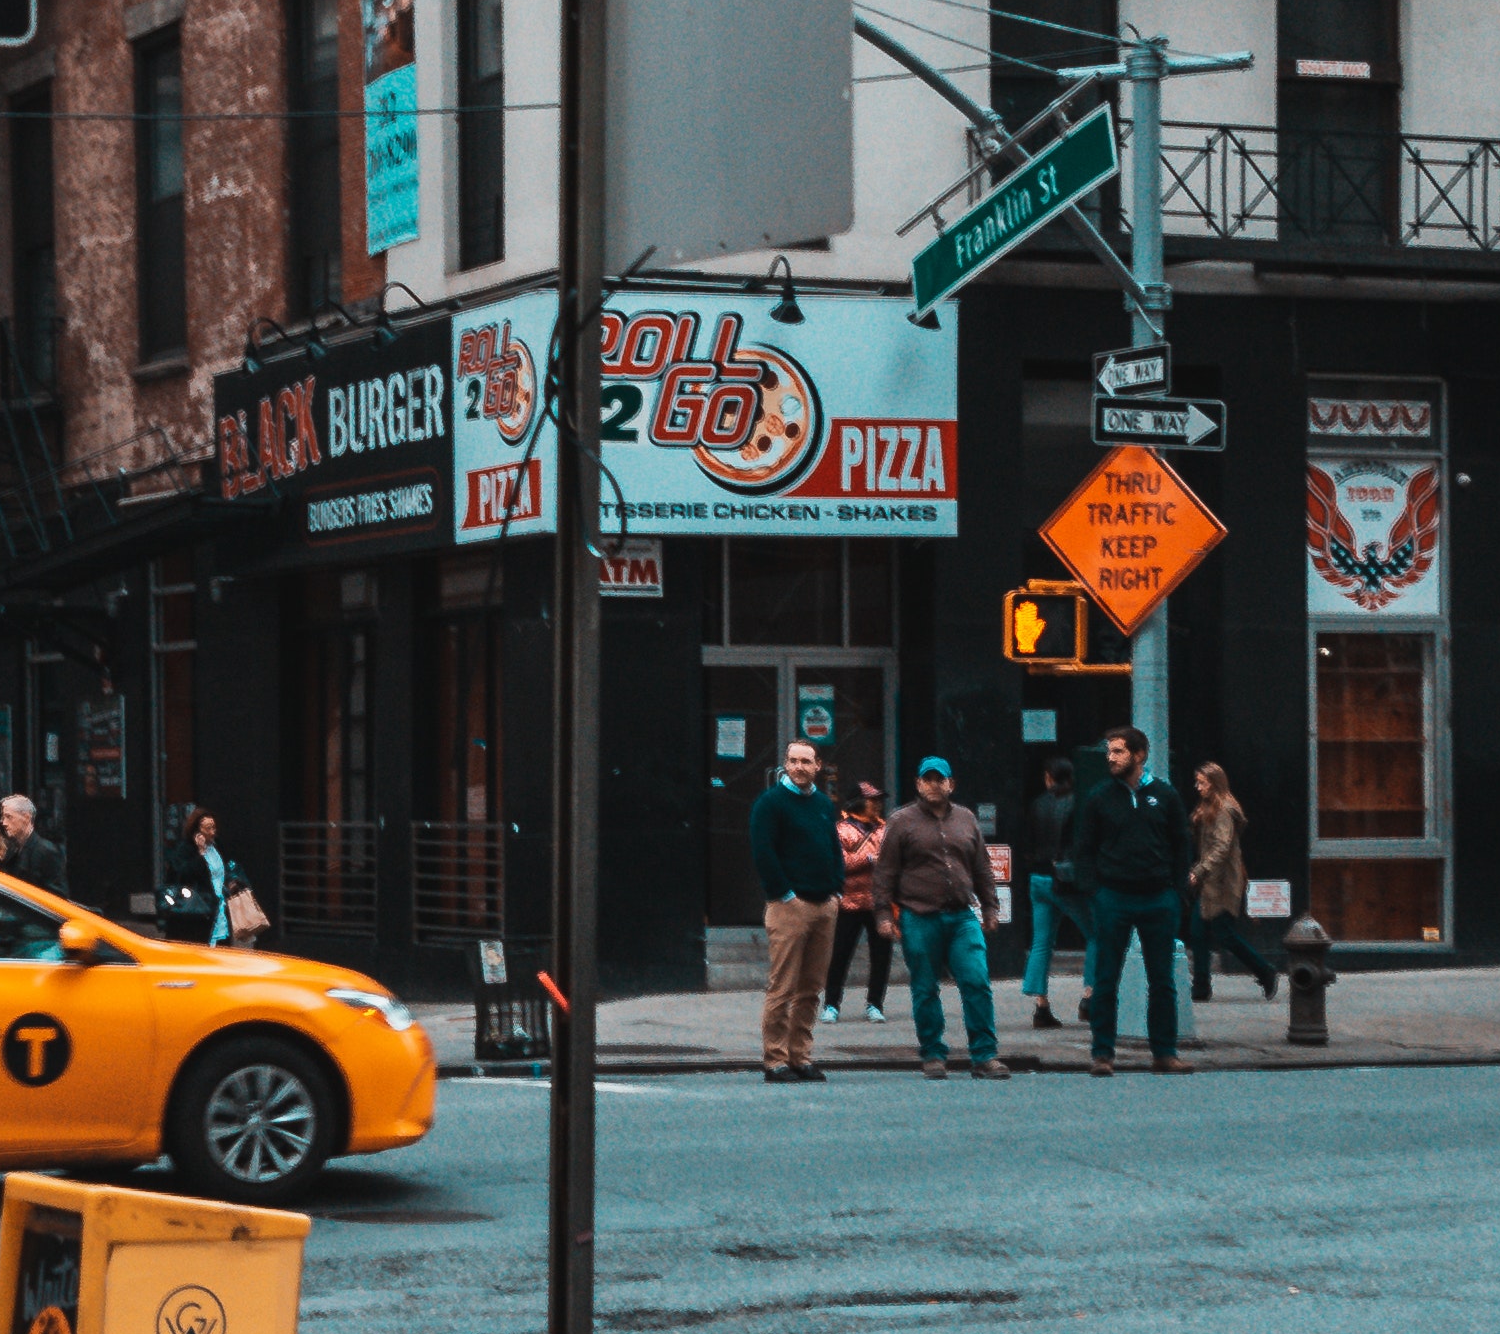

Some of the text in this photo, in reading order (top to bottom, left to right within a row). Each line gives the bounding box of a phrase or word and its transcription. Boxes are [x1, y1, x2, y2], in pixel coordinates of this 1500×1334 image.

[954, 162, 1060, 268] Franklin St
[457, 319, 521, 383] ROLL
[1133, 361, 1159, 381] WAY
[466, 376, 483, 421] 2
[600, 362, 762, 450] 2 GO
[219, 363, 445, 501] BLACK BURGER
[1108, 411, 1190, 435] ONE WAY
[839, 424, 946, 493] PIZZA
[478, 467, 533, 523] PIZZA
[1105, 471, 1163, 496] THRU
[600, 501, 707, 519] TISSERIE
[713, 503, 821, 522] CHICKEN
[837, 504, 938, 523] SHAKES
[1087, 502, 1177, 527] TRAFFIC
[1102, 534, 1158, 560] KEEP
[1100, 566, 1163, 591] RIGHT
[14, 1025, 58, 1078] T
